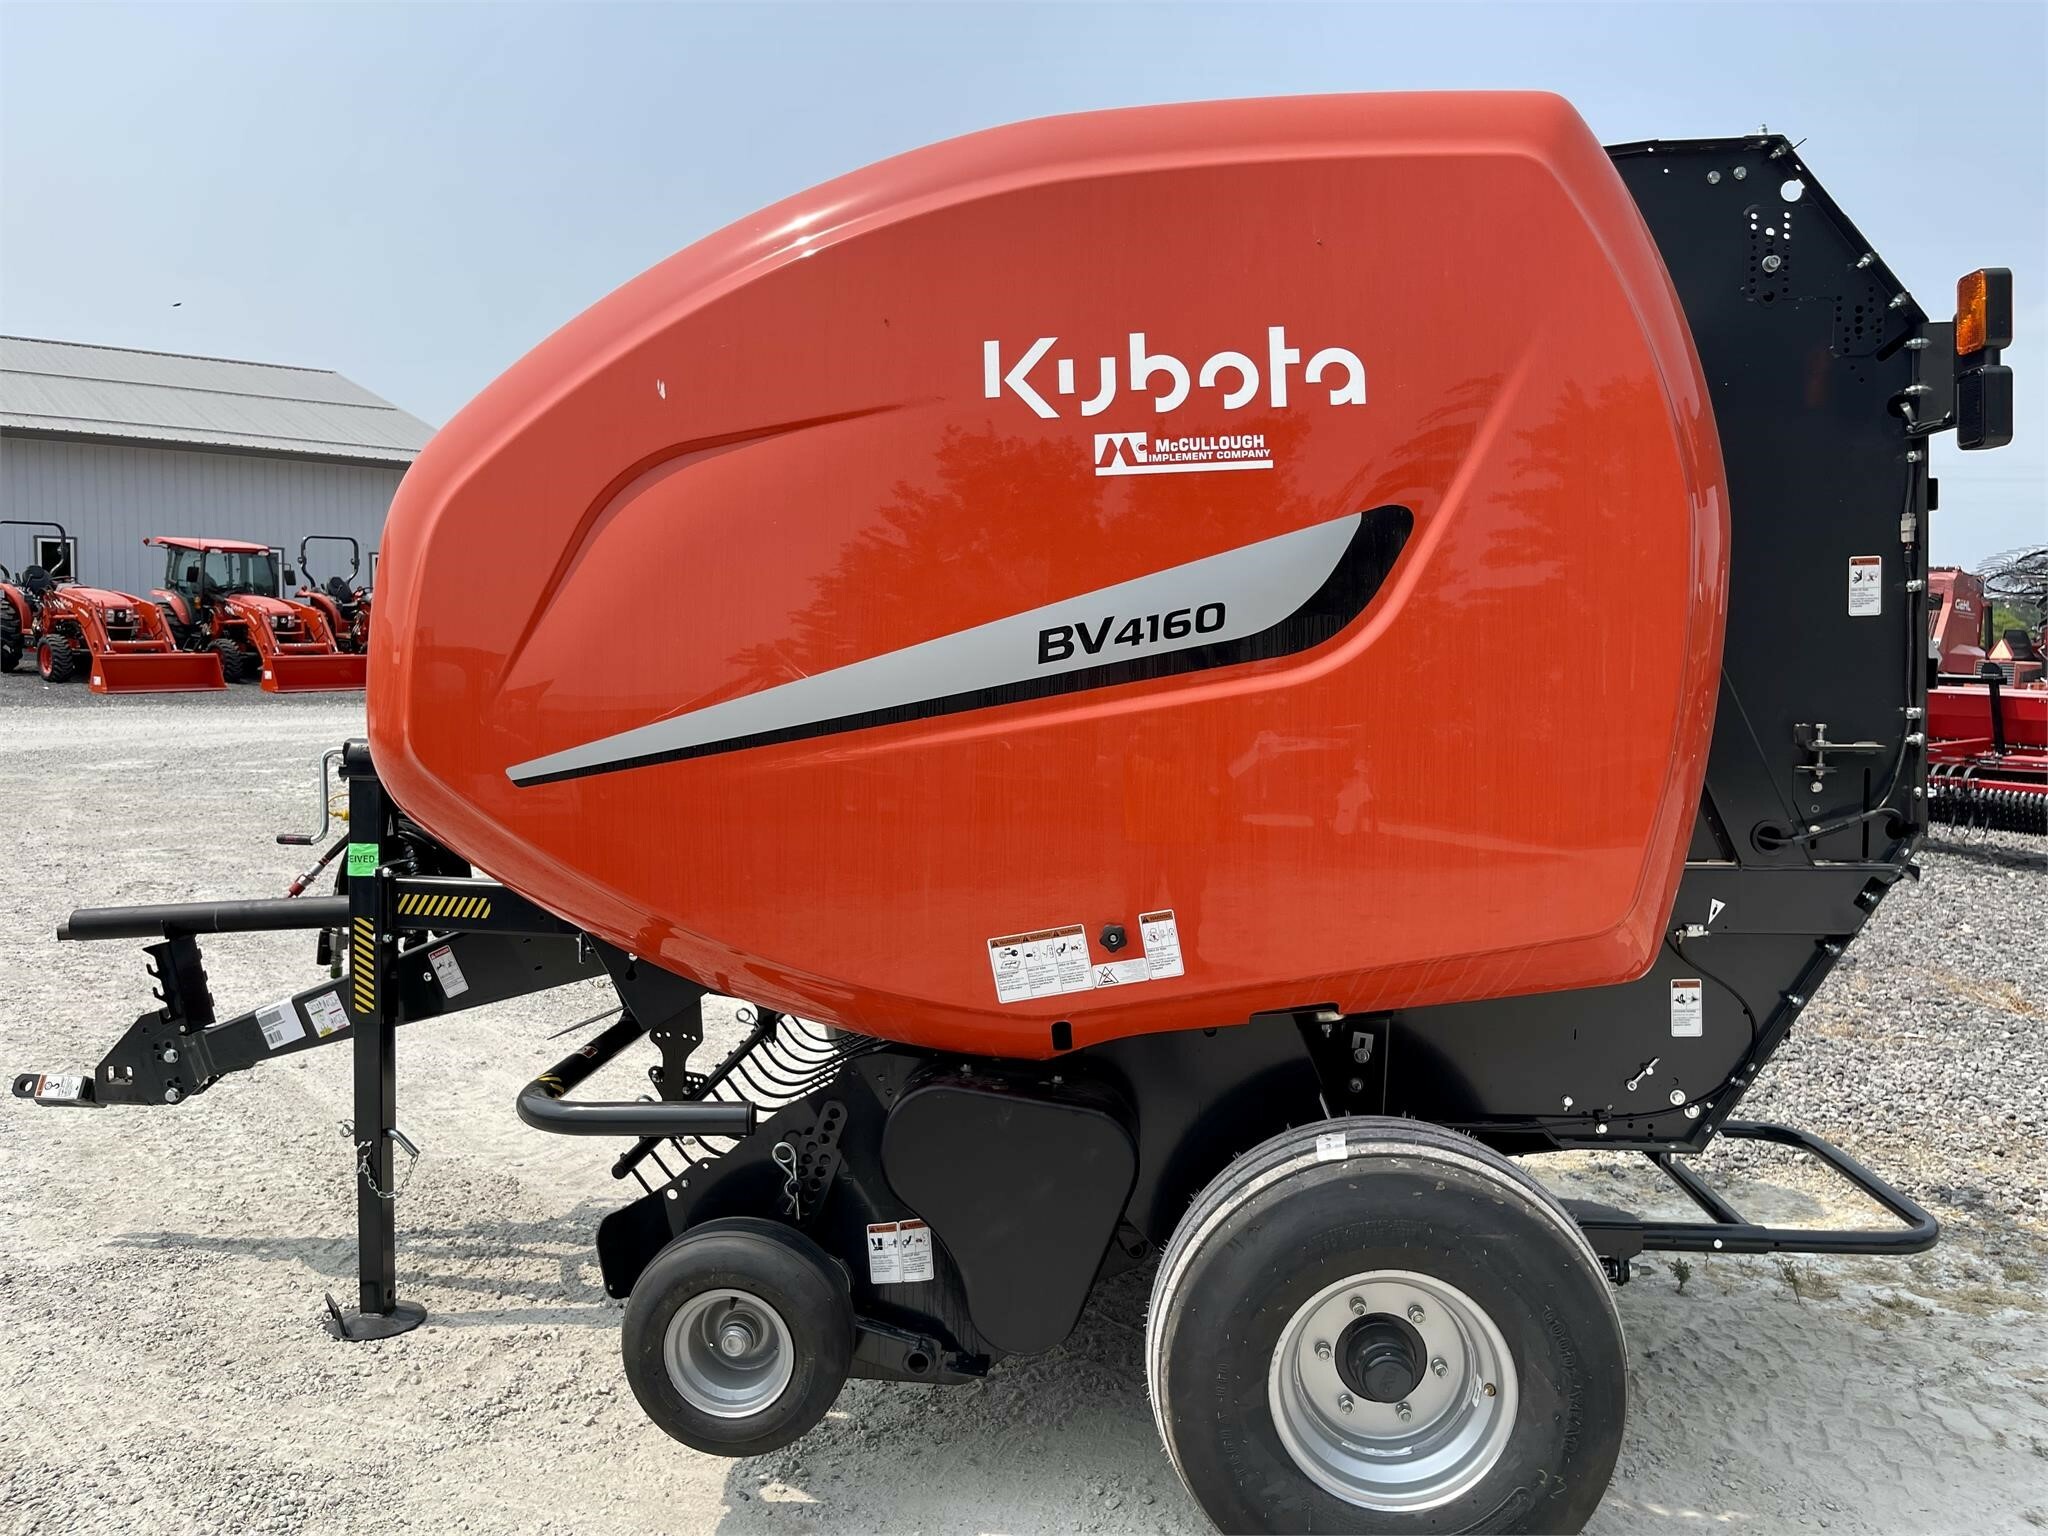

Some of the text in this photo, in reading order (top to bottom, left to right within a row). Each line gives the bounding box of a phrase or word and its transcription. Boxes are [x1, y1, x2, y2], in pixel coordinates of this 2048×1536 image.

[983, 326, 1366, 419] Kubota
[1149, 448, 1271, 462] IMPLEMENT COMPANY
[1155, 434, 1265, 453] McCULLOUGH
[1037, 601, 1227, 665] BV4160
